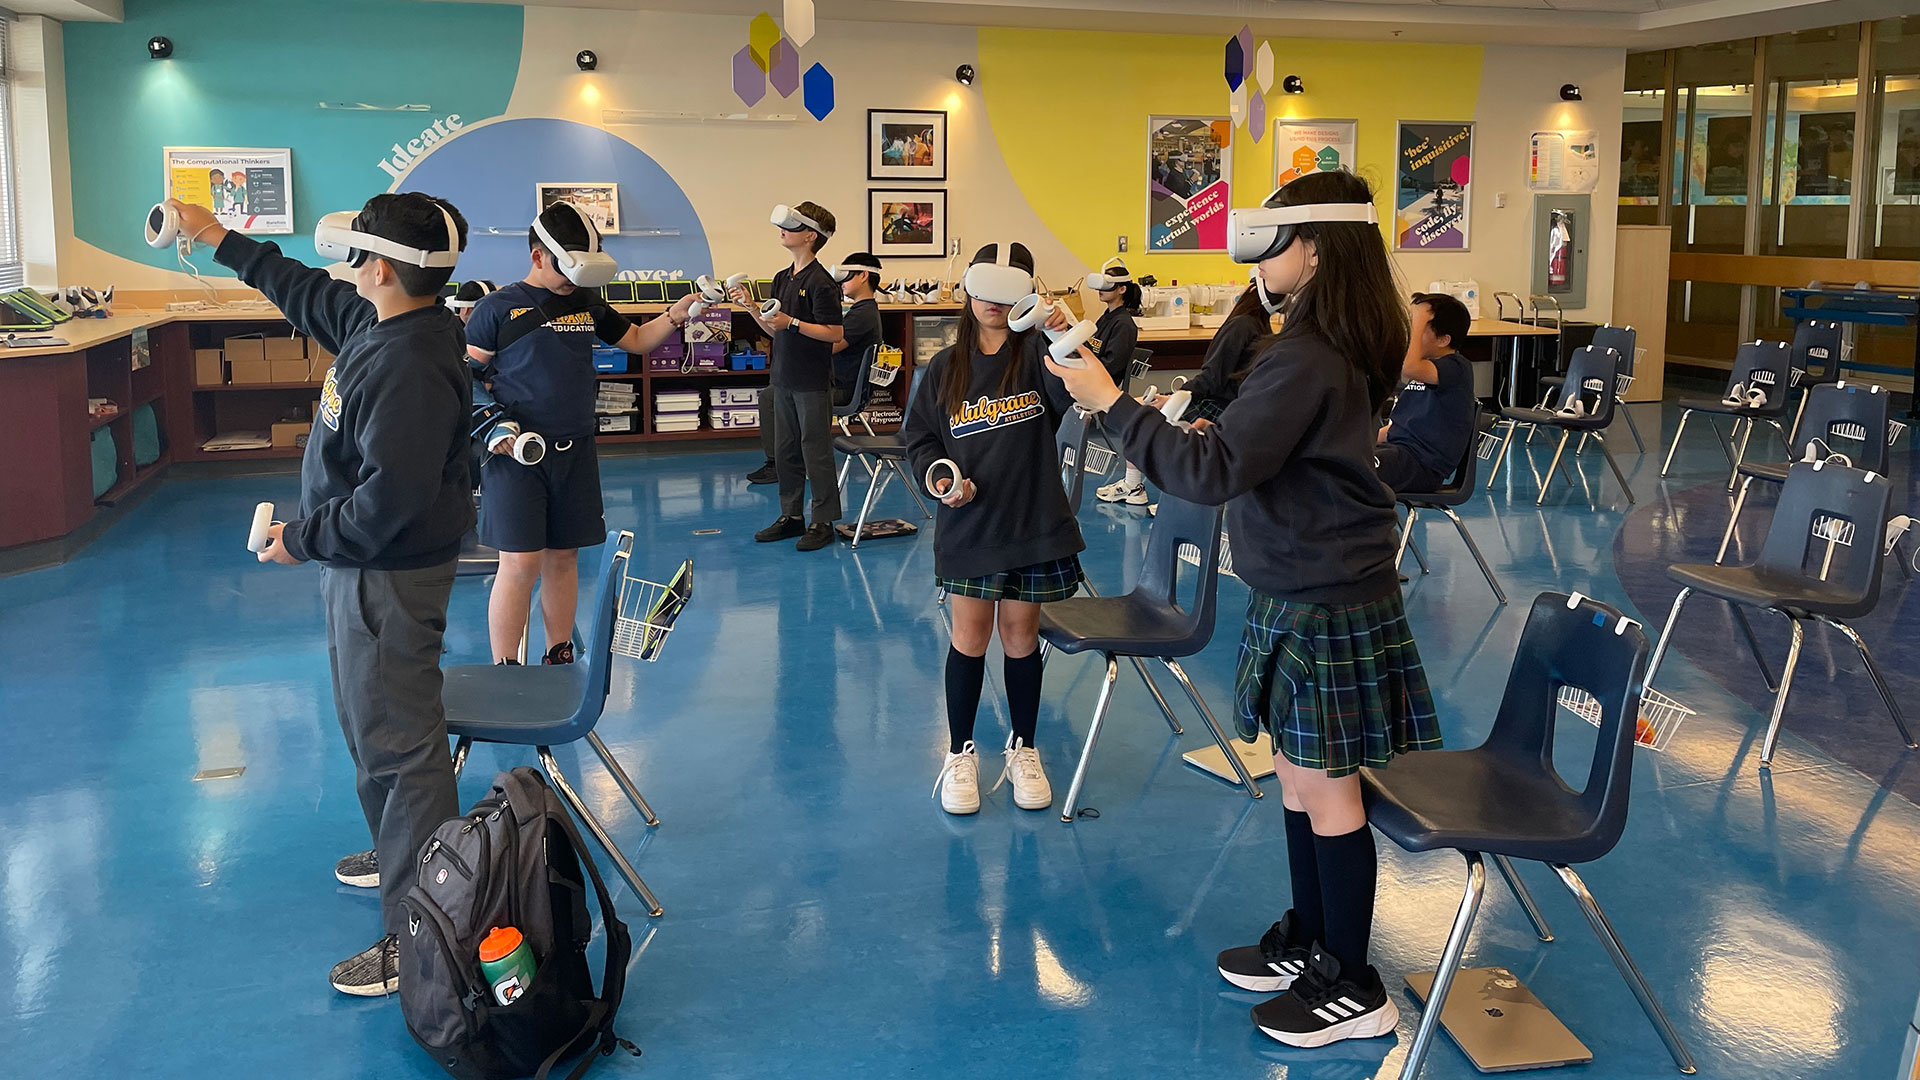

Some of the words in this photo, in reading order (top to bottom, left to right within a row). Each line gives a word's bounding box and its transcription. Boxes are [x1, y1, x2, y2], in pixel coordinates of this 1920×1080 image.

[377, 113, 463, 179] Ideate
[1409, 127, 1469, 171] inquisitive!
[1155, 221, 1191, 247] virtual
[1190, 202, 1224, 226] worlds
[1165, 191, 1219, 227] experience
[1415, 214, 1444, 236] code,
[1443, 203, 1457, 218] fly
[1420, 213, 1463, 247] discover
[616, 269, 684, 281] over
[870, 416, 902, 424] Playground
[950, 391, 1040, 428] Mulgrave
[1004, 408, 1037, 422] ATHLETICS
